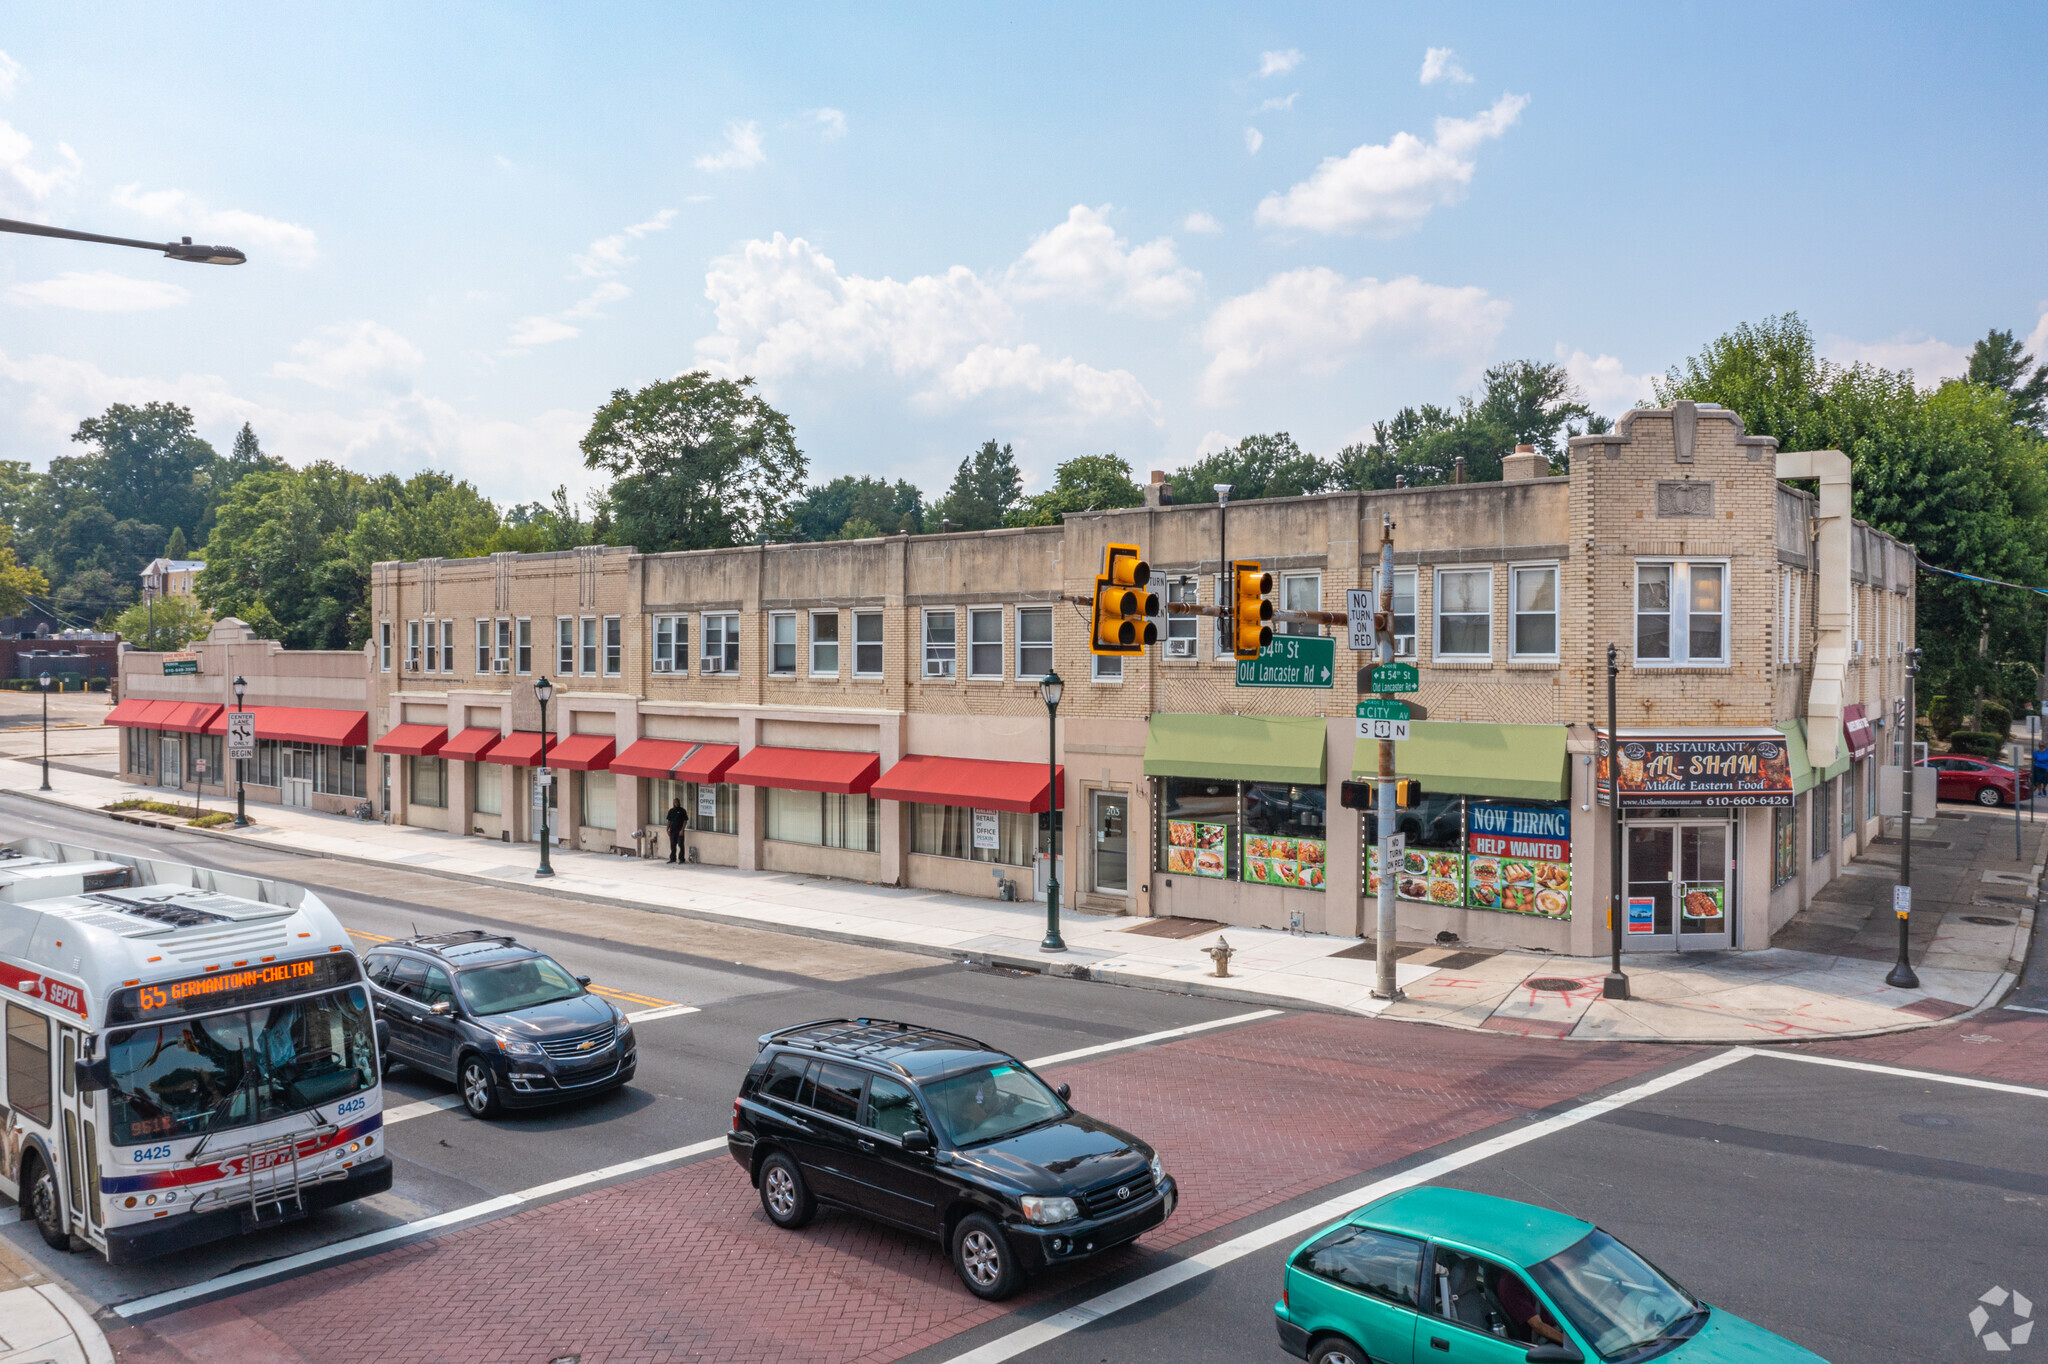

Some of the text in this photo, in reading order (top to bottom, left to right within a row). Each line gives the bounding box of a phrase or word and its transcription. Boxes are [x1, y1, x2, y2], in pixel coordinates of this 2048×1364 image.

[1353, 593, 1367, 608] NO
[1352, 610, 1370, 620] TURN
[1356, 622, 1366, 632] ON
[1354, 634, 1372, 646] RED
[1287, 641, 1299, 658] St
[1240, 662, 1314, 682] Old Lancaster Rd
[1404, 671, 1410, 680] St
[1382, 683, 1404, 692] Lancaster
[1405, 682, 1412, 690] Rd
[1366, 707, 1408, 720] CITY AV
[1361, 722, 1405, 736] S 1 N
[1656, 742, 1745, 752] RESTAURANT
[1690, 755, 1757, 776] SHAM
[1645, 778, 1766, 790] Middle Eastern Food
[1706, 796, 1789, 806] 610-660-6426
[1106, 808, 1120, 816] 203
[1474, 808, 1565, 836] NOW HIRING
[1392, 838, 1399, 847] NO
[1477, 838, 1562, 859] HELP WANTED
[1390, 849, 1402, 858] TURN
[1394, 858, 1404, 867] RED
[140, 961, 314, 1010] 65 GERMANTOWN-CHELTEN
[50, 984, 78, 1010] SEPTA
[337, 1097, 366, 1116] 8425
[134, 1145, 171, 1162] 8425
